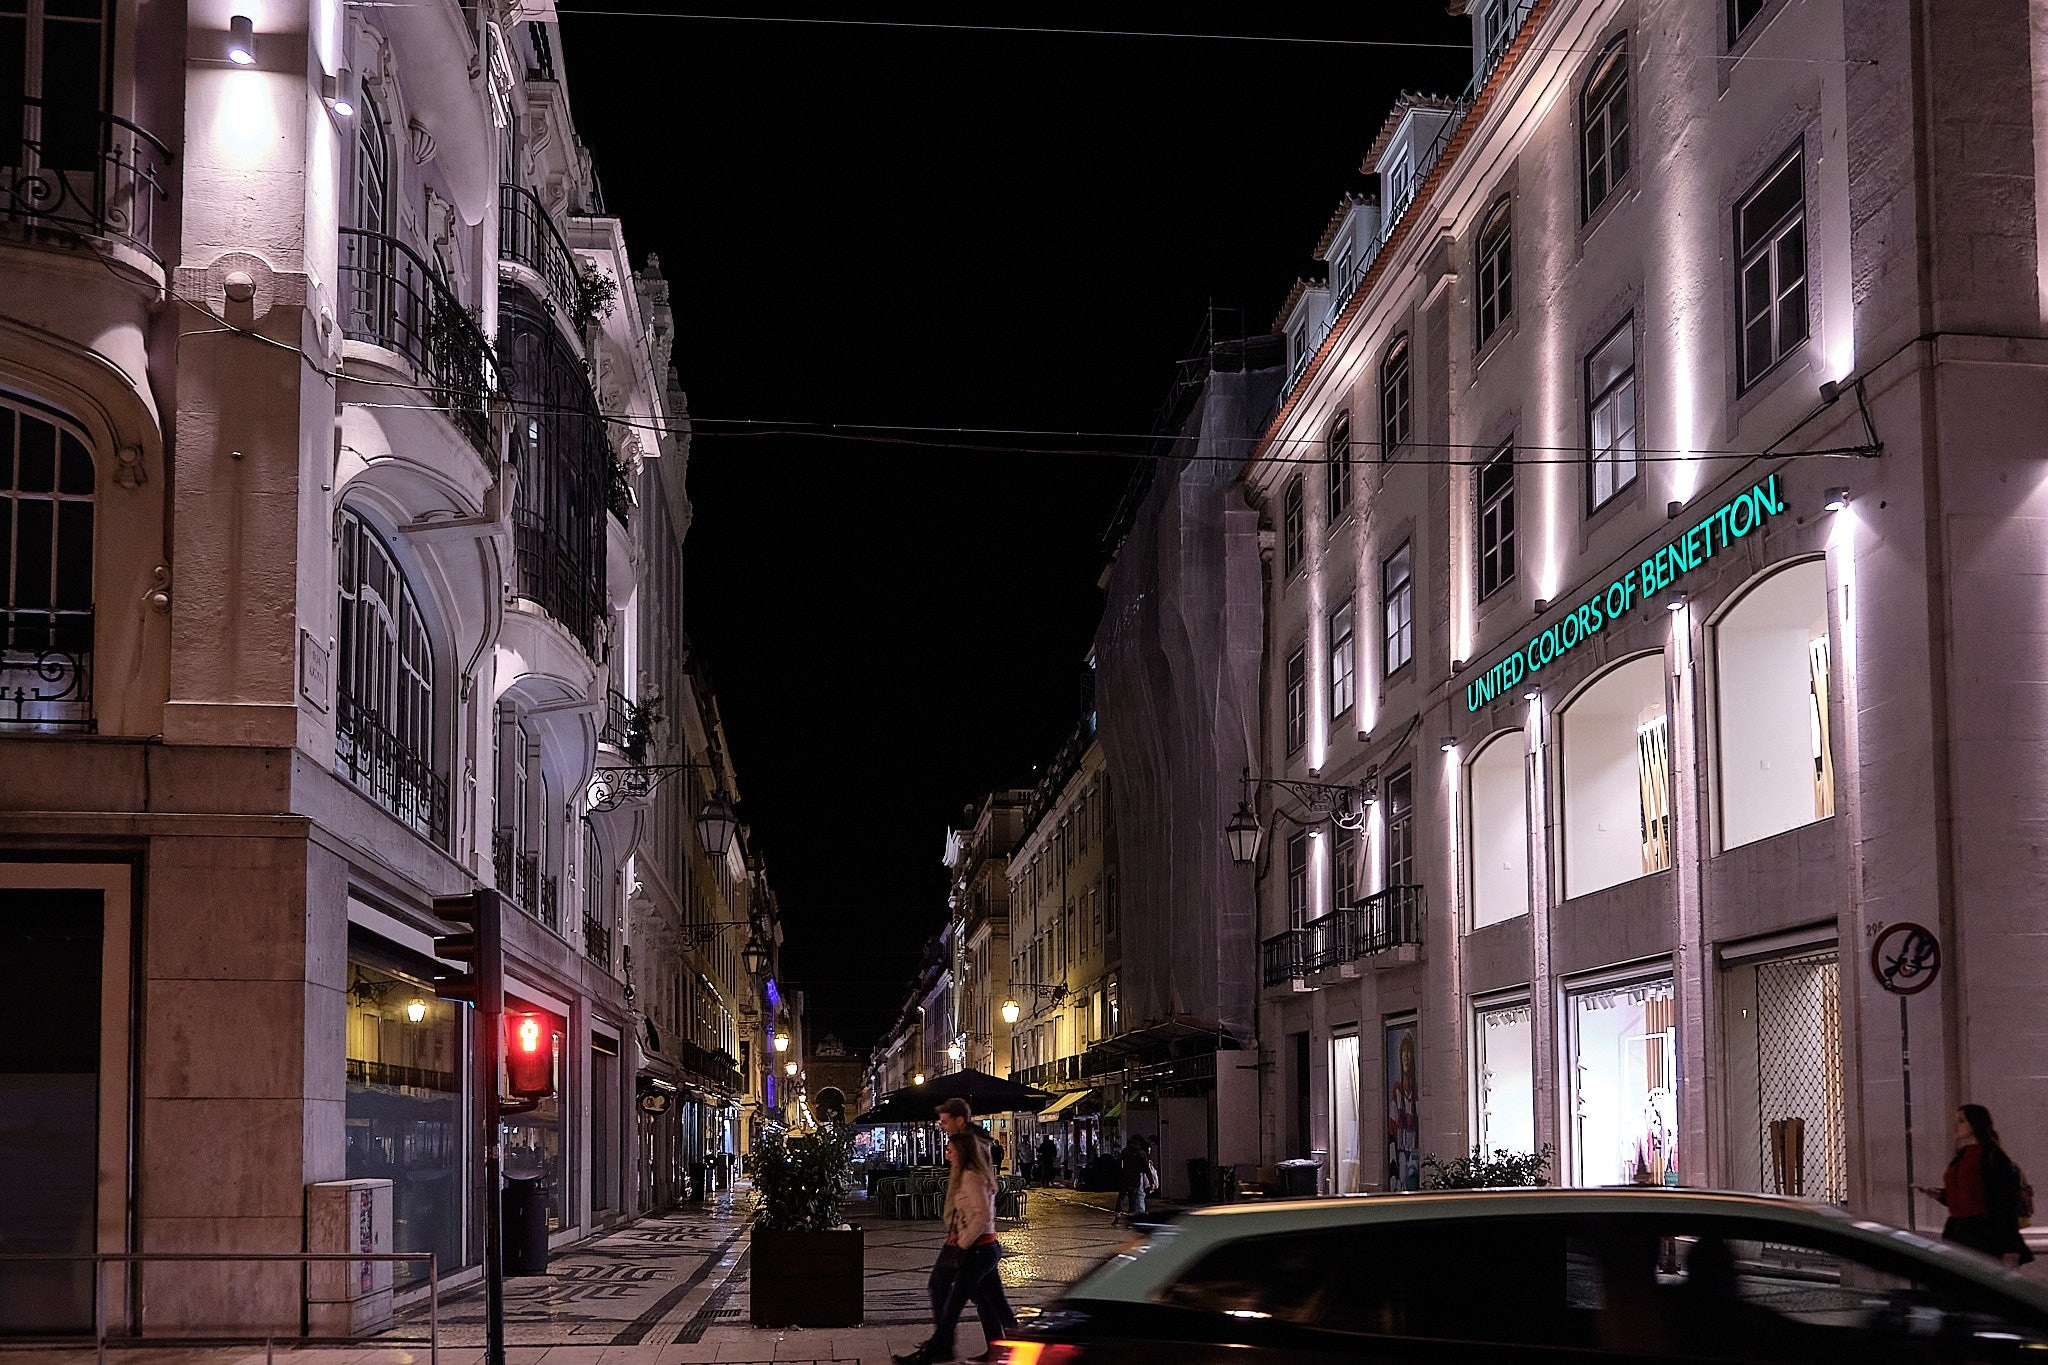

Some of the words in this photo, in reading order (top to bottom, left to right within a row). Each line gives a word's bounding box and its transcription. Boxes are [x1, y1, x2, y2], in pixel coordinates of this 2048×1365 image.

[1467, 652, 1524, 712] UNITED
[1528, 596, 1603, 672] COLORS
[1606, 571, 1637, 619] OF
[1641, 474, 1785, 599] BENETTON.
